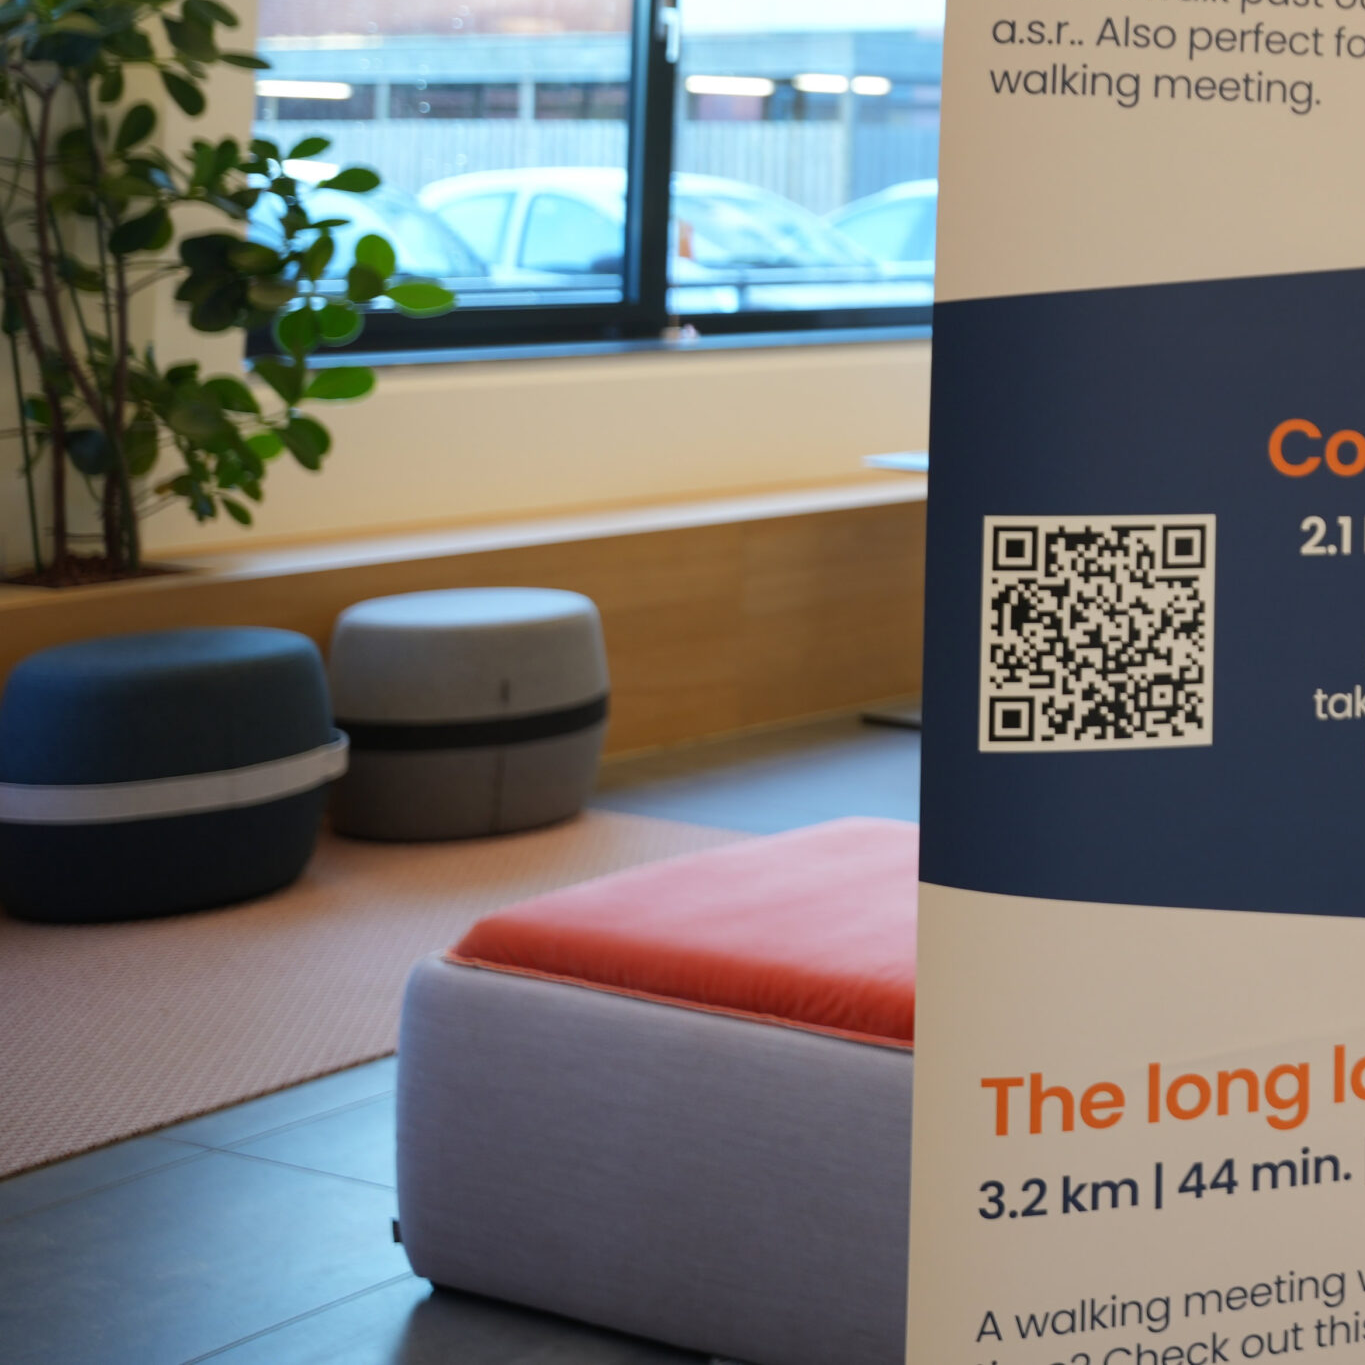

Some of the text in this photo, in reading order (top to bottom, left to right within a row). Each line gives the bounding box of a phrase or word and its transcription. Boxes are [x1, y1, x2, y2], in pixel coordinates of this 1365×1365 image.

[991, 19, 1084, 46] a.s.r..
[1095, 15, 1177, 50] Also
[1188, 21, 1324, 61] perfect
[989, 62, 1321, 116] walking meeting.
[1300, 515, 1352, 556] 2.1
[980, 1072, 1126, 1137] The
[1147, 1062, 1310, 1131] long
[978, 1177, 1048, 1220] 3.2
[1061, 1175, 1139, 1215] km
[1177, 1158, 1239, 1199] 44
[1251, 1146, 1352, 1192] min.
[975, 1310, 1003, 1343] A
[1014, 1294, 1171, 1340] walking
[1184, 1270, 1346, 1318] meeting
[1102, 1331, 1230, 1365] Check
[1240, 1322, 1304, 1359] out
